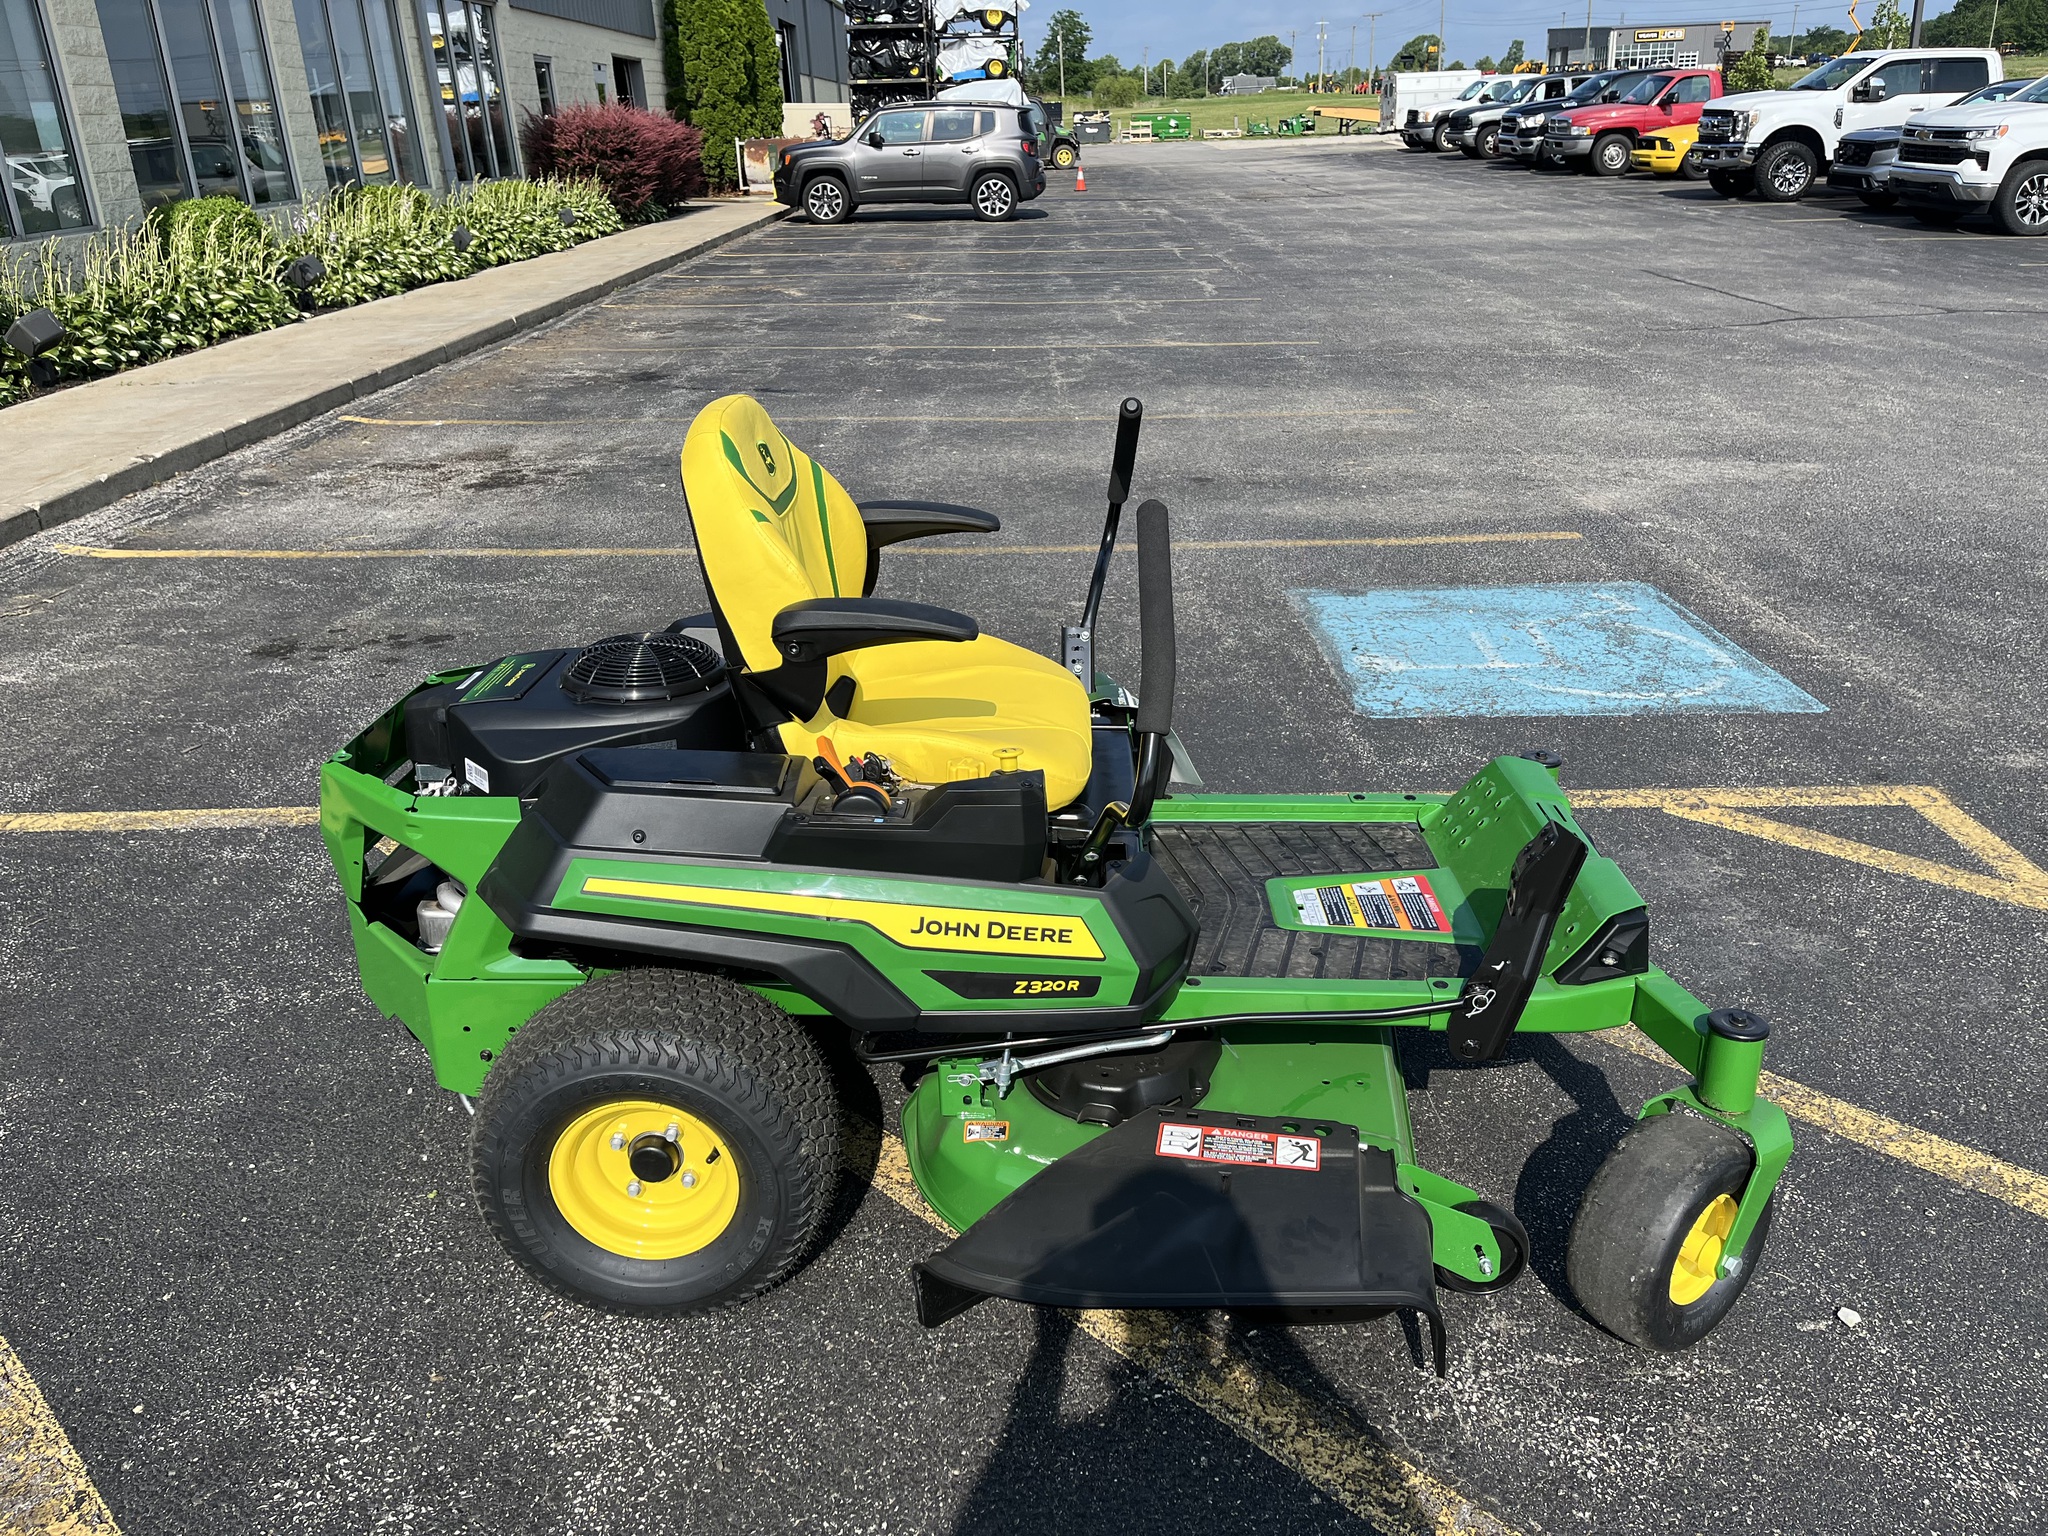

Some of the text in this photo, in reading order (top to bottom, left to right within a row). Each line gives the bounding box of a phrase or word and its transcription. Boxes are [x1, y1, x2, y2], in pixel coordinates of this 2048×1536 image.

[910, 916, 1073, 944] JOHN DEERE
[1223, 1129, 1269, 1141] DANGER
[502, 1188, 562, 1270] SUPER
